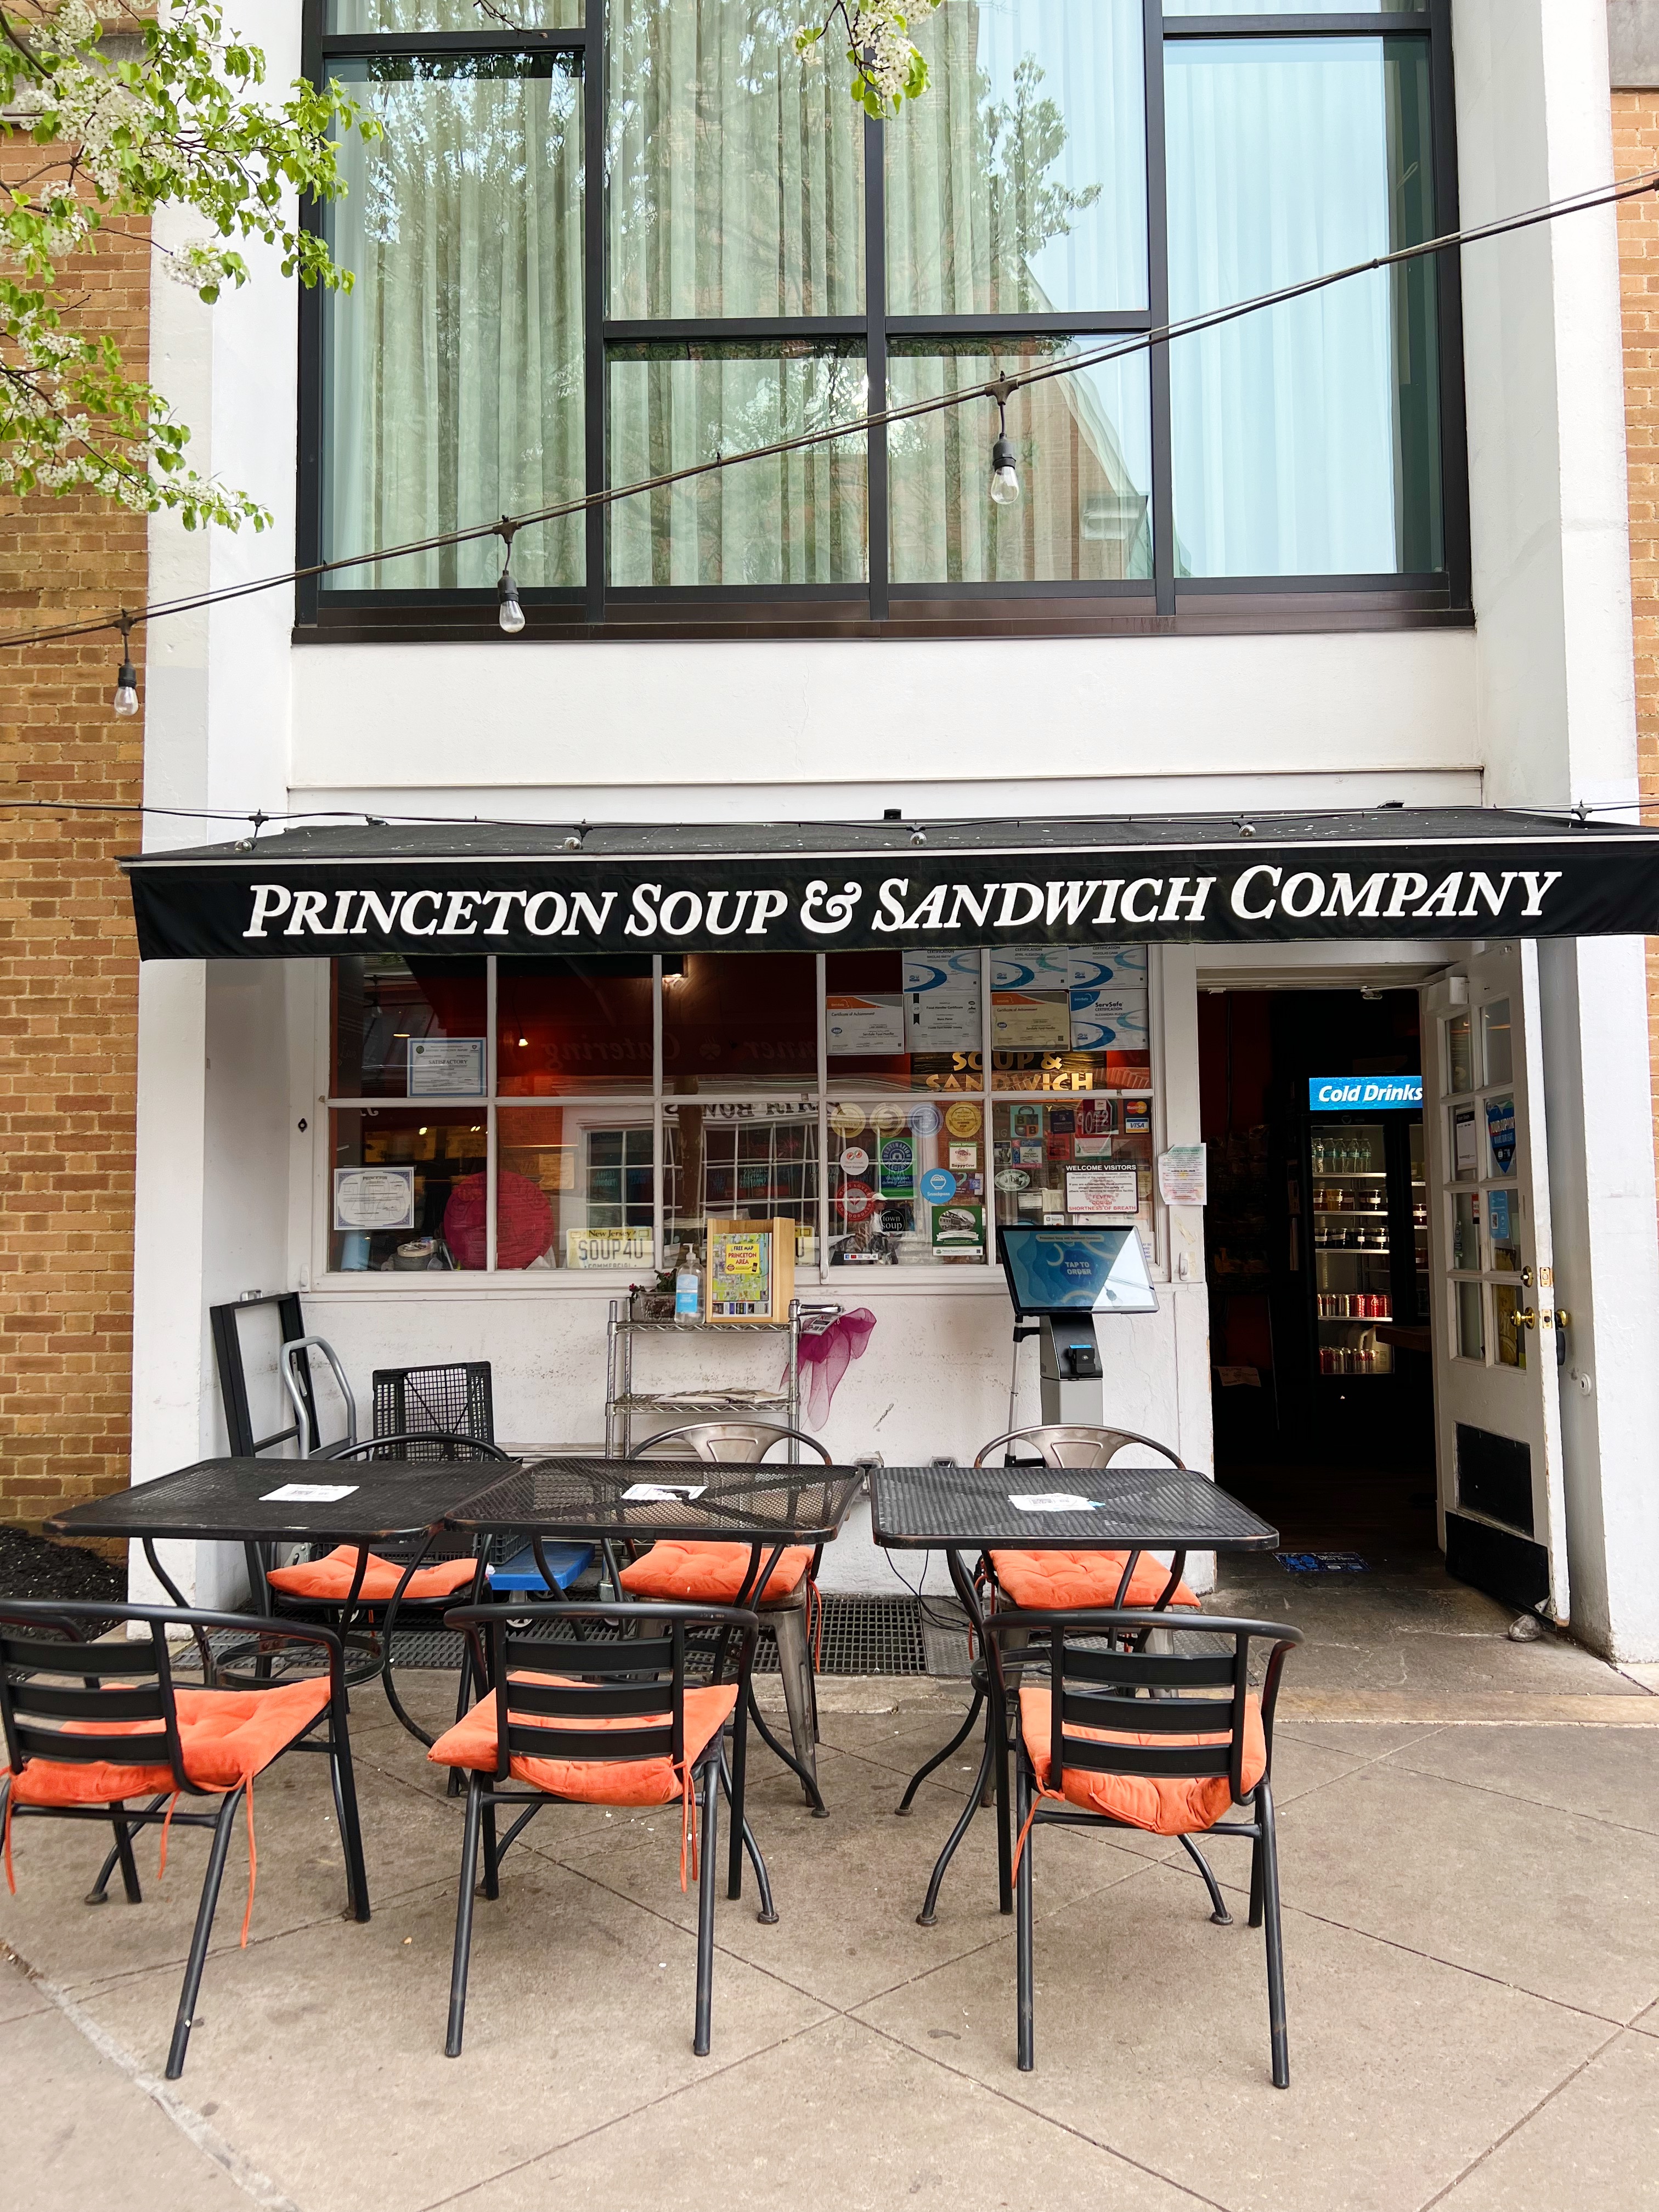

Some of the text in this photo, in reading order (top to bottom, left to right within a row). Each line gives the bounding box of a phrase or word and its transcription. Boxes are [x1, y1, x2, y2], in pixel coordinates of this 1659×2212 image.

[242, 864, 1562, 938] PRINCETON SOUP & SANDWICH COMPANY
[1318, 1084, 1423, 1102] Cold Drinks
[607, 1229, 631, 1238] Jersey
[579, 1238, 644, 1261] SOUP4U
